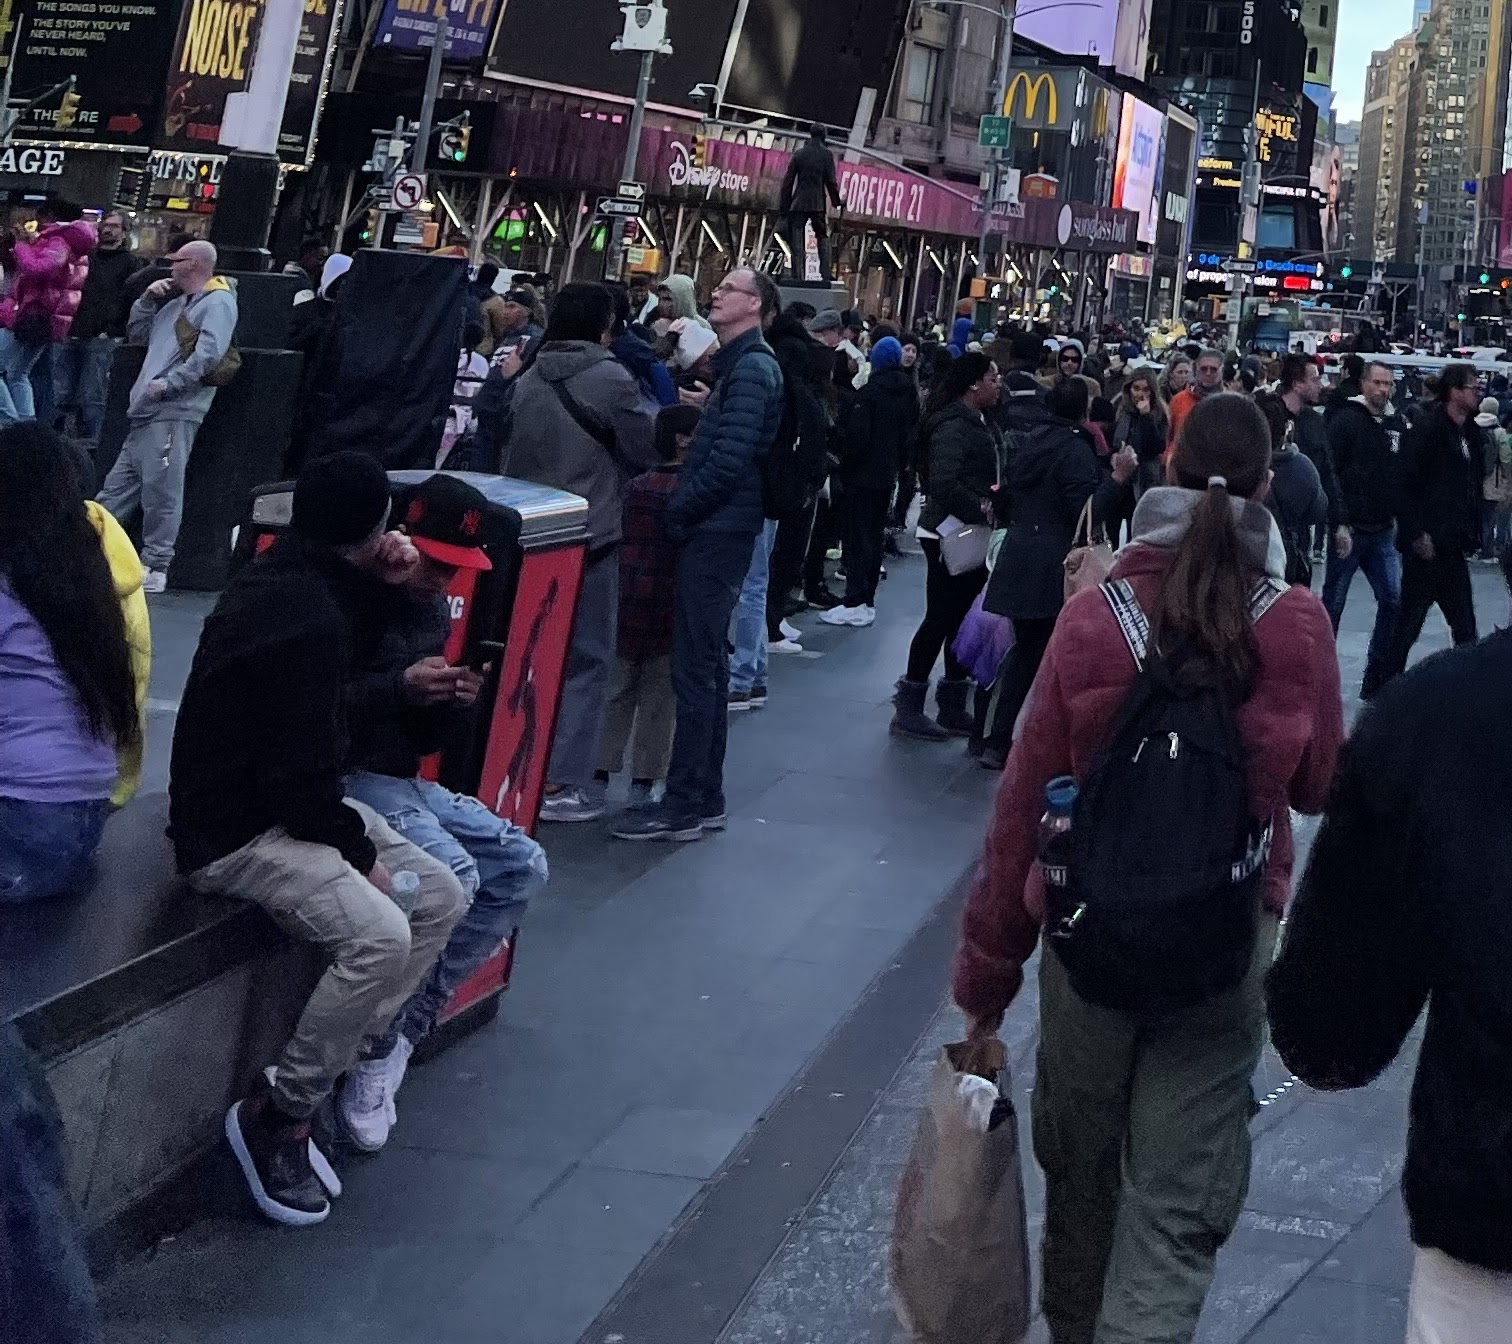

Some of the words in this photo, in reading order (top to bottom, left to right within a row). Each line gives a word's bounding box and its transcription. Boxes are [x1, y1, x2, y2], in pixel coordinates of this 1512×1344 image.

[719, 172, 750, 193] store
[839, 170, 905, 219] FOREVER
[906, 184, 926, 223] 21
[1072, 211, 1113, 247] sunglass
[1111, 216, 1128, 243] hut
